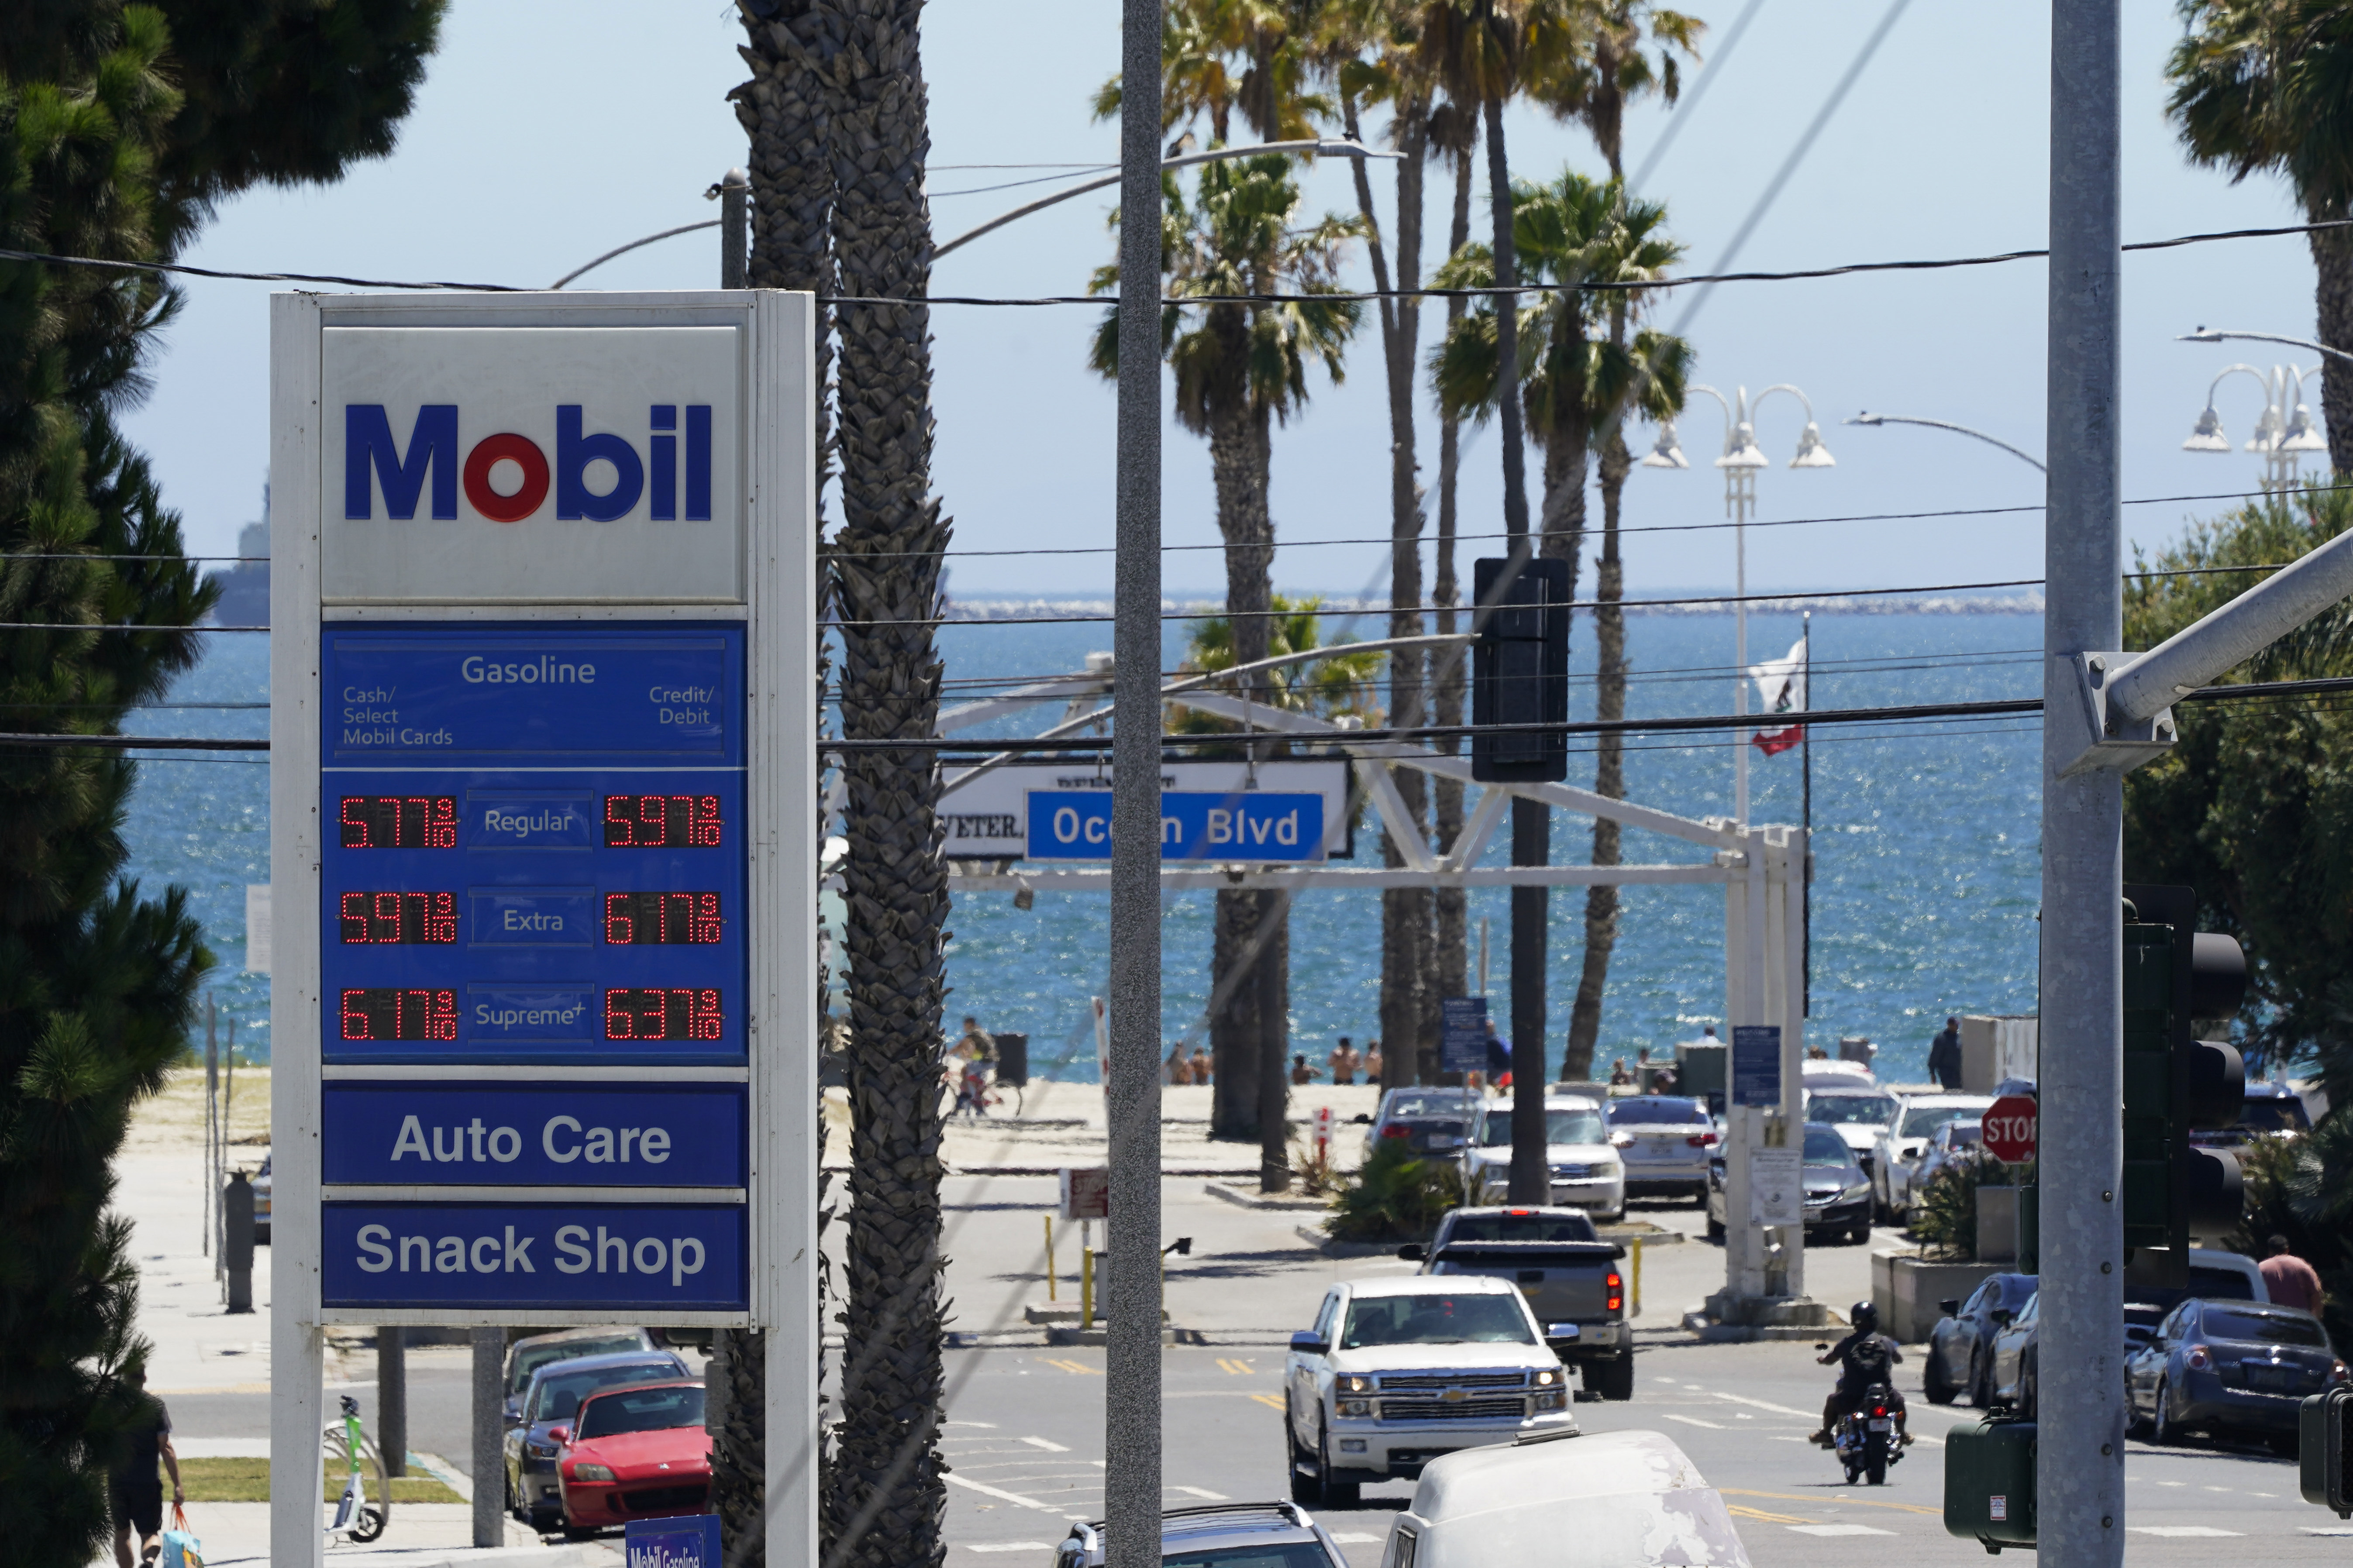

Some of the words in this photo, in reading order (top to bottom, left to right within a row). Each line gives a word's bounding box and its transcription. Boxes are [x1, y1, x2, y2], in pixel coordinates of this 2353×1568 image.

[345, 404, 711, 523] Mobil
[462, 655, 596, 684] Gasoline
[343, 686, 396, 704] Cash/
[649, 686, 715, 704] Credit/
[344, 708, 399, 724] Select
[660, 708, 710, 725] Debit
[344, 729, 395, 745] Mobil
[400, 729, 453, 745] Cards
[485, 810, 573, 838] Regular
[1053, 807, 1182, 844] Ocn
[1207, 808, 1298, 846] Blvd
[504, 909, 563, 931] Extra
[390, 1115, 522, 1163] Auto
[542, 1115, 671, 1164] Care
[356, 1224, 536, 1274] Snack
[554, 1225, 706, 1286] Shop
